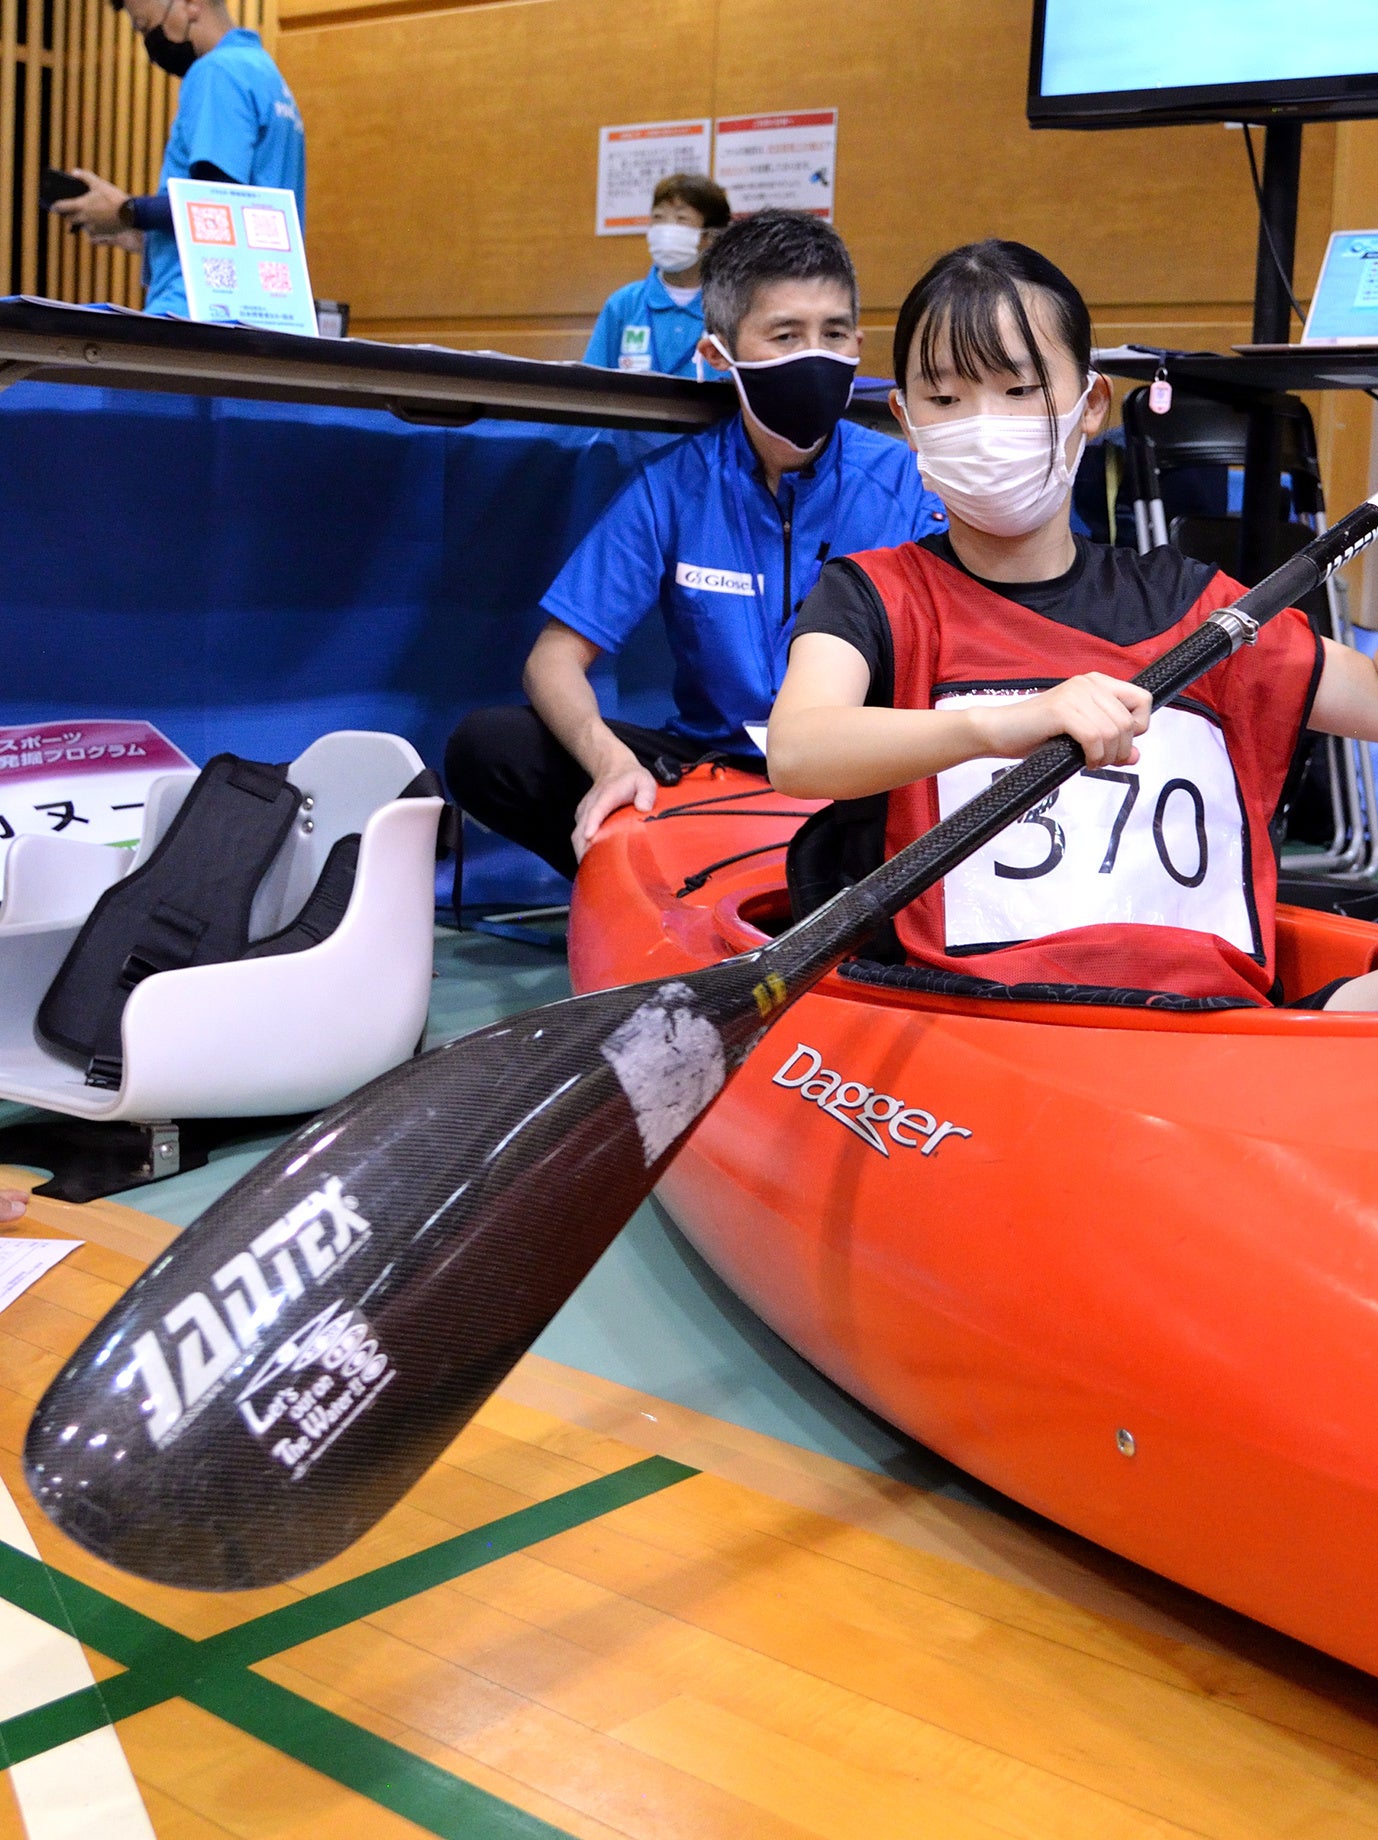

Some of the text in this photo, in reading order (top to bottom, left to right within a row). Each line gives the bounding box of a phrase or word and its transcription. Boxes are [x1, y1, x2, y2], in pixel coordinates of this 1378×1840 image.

[0, 732, 82, 752] スポーツ
[0, 800, 144, 839] ヌー
[771, 1042, 973, 1158] Dagger
